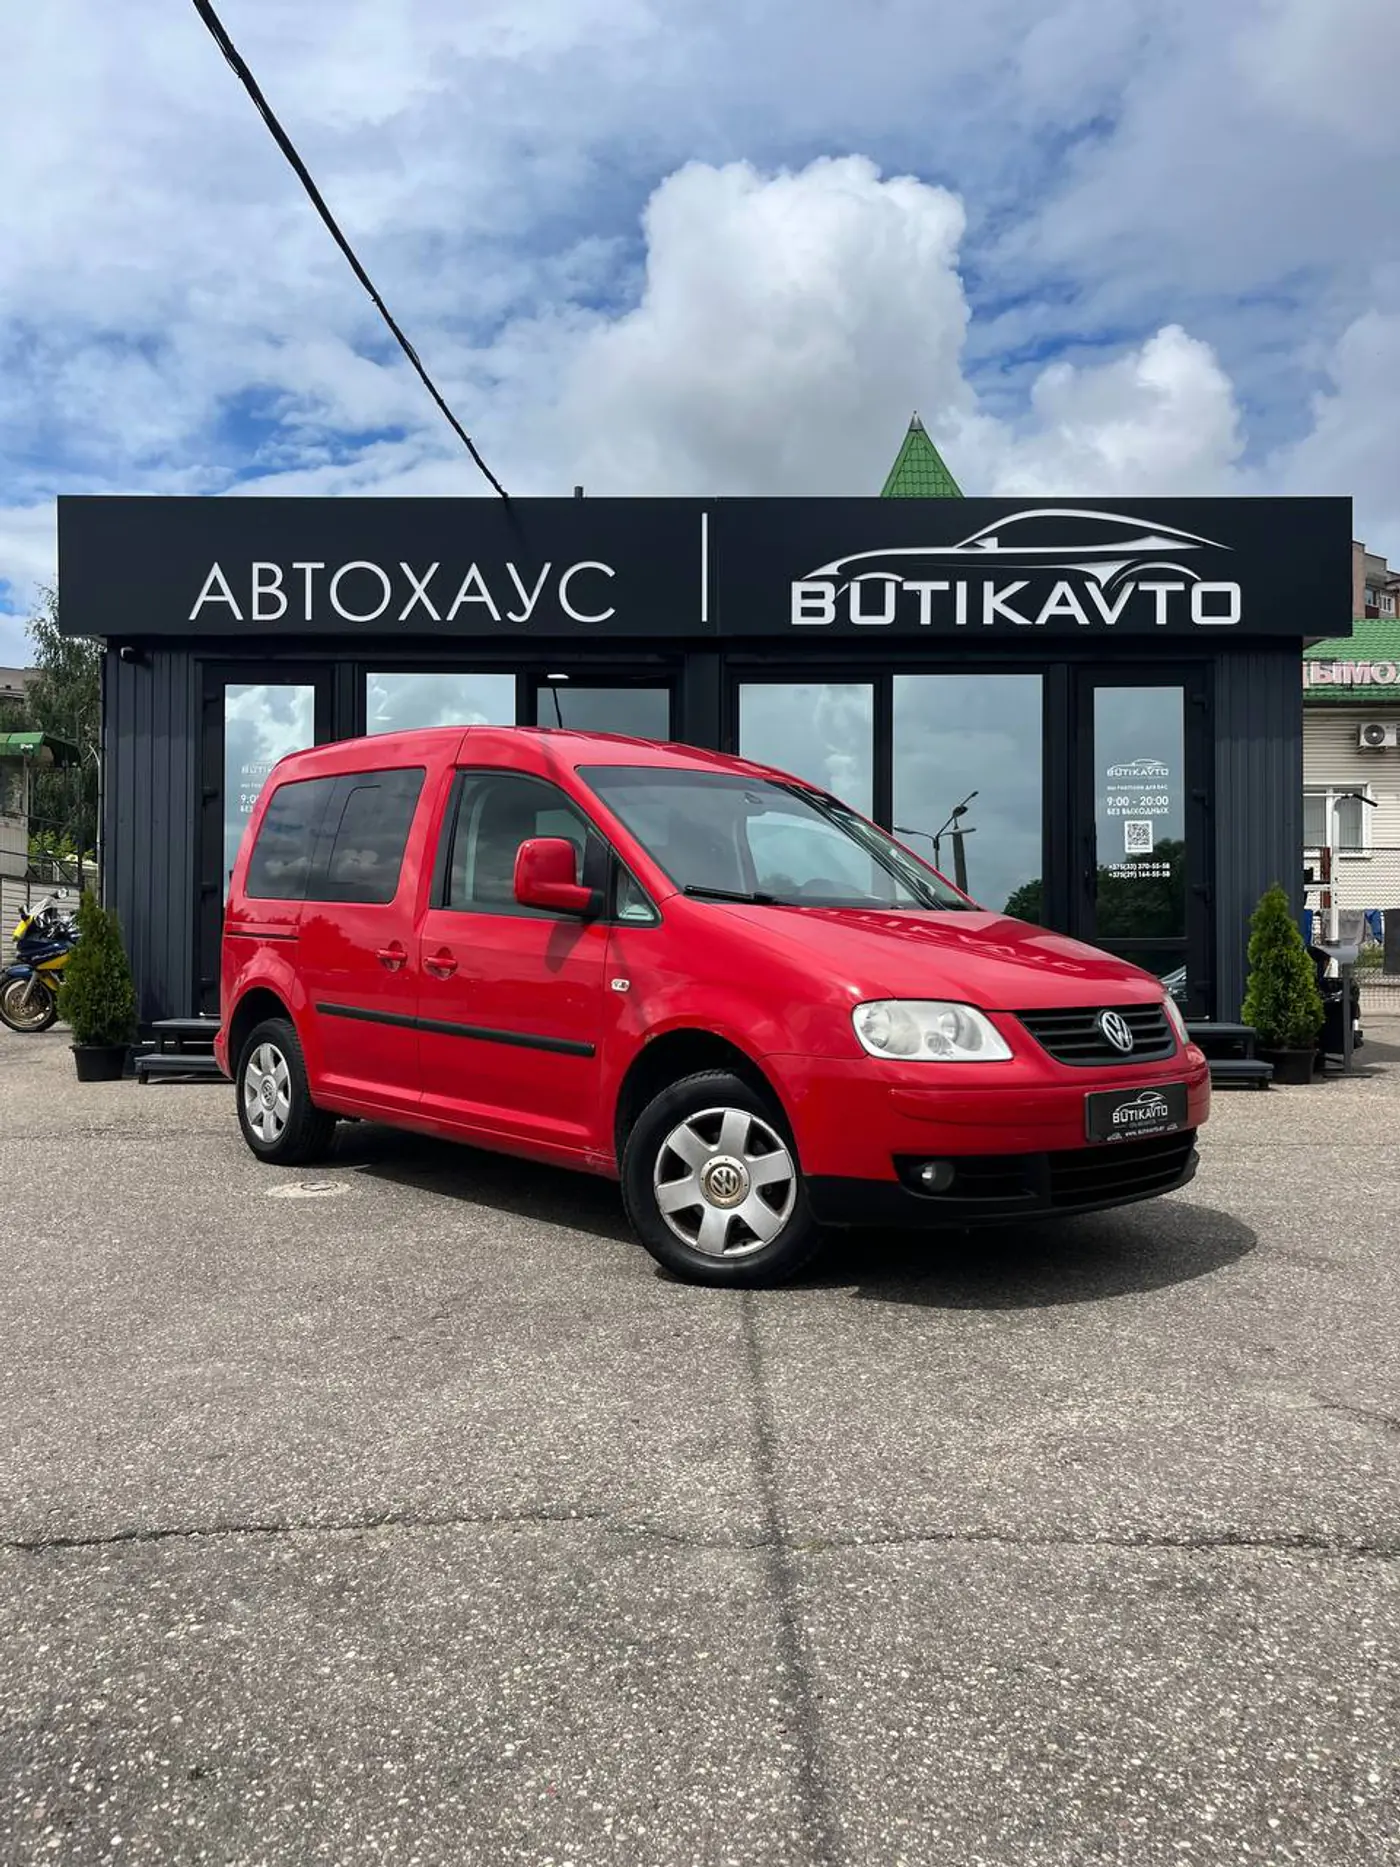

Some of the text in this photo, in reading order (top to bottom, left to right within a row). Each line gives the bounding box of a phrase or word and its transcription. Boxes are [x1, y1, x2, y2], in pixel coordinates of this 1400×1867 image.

[188, 561, 616, 622] АВТОХАУС
[791, 580, 1241, 626] BUTIKAVTO
[1303, 661, 1400, 688] ЫМО
[240, 794, 259, 804] 9:0
[1107, 796, 1129, 806] 9:00
[1140, 796, 1169, 806] 20:00
[1113, 1105, 1168, 1123] BUTIKAVTO
